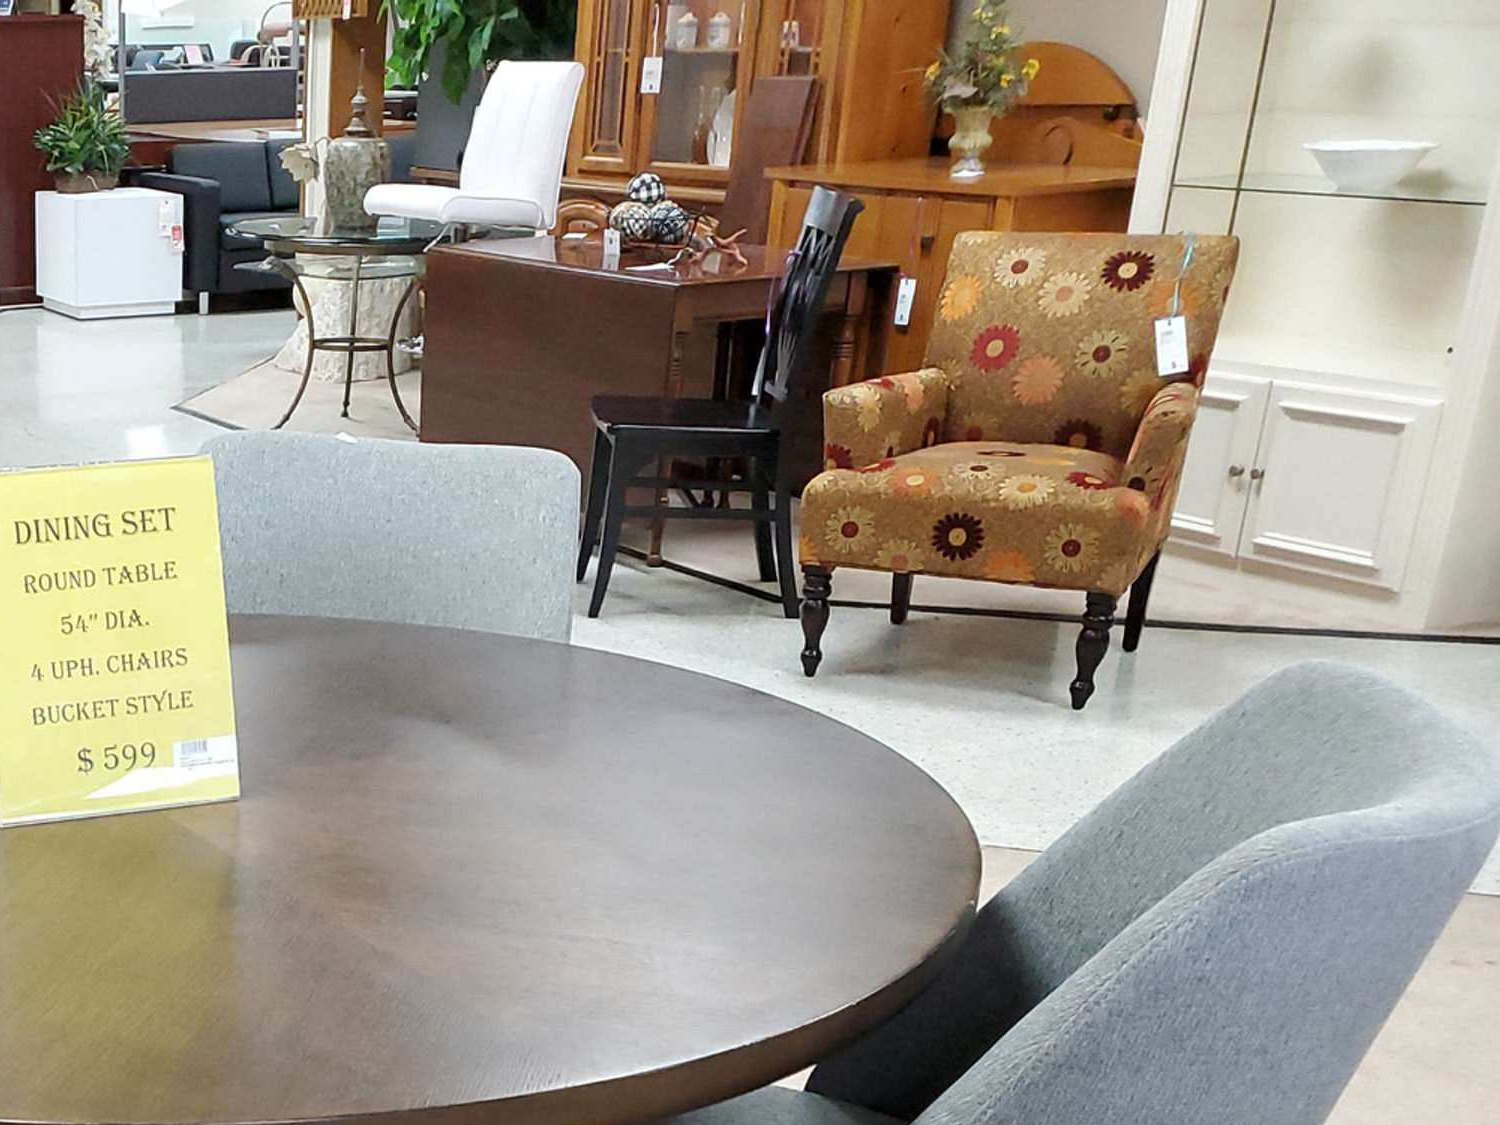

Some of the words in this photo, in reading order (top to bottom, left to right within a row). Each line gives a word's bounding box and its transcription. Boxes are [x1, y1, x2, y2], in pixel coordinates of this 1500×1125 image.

[14, 514, 113, 545] DINING
[121, 506, 176, 535] SET
[23, 569, 96, 594] ROUND
[102, 560, 178, 586] TABLE
[60, 613, 98, 635] 54"
[105, 608, 150, 630] DIA.
[30, 663, 45, 682] 4
[51, 657, 100, 680] UPH.
[106, 647, 189, 674] CHAIRS
[32, 698, 120, 726] BUCKET
[125, 689, 194, 715] STYLE
